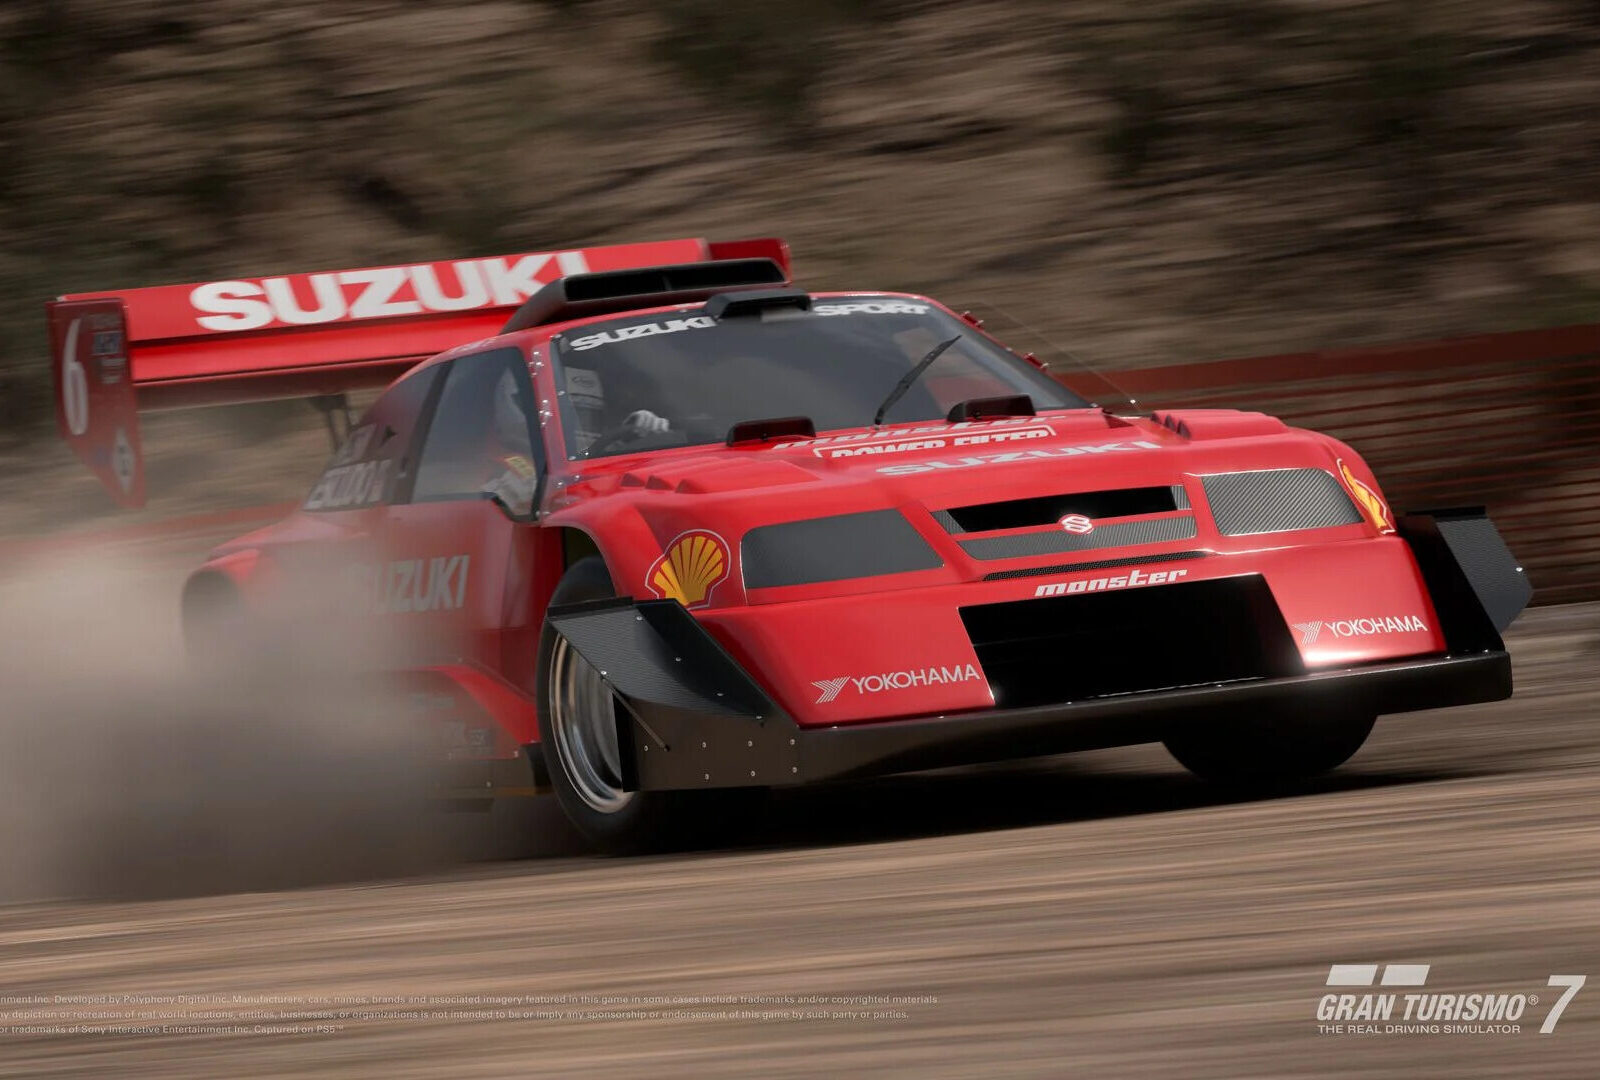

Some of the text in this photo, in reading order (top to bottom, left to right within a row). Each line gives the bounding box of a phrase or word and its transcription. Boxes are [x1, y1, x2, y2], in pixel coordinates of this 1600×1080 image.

[190, 250, 592, 331] SUZUKI
[813, 301, 930, 316] SPORT
[570, 316, 718, 351] SUZUKI
[62, 318, 88, 436] 6
[875, 440, 1162, 476] SUZUKI
[350, 554, 470, 615] UZUKI
[1034, 569, 1188, 597] monster
[1325, 615, 1428, 638] YOKOHAMA
[852, 663, 981, 694] YOKOHAMA
